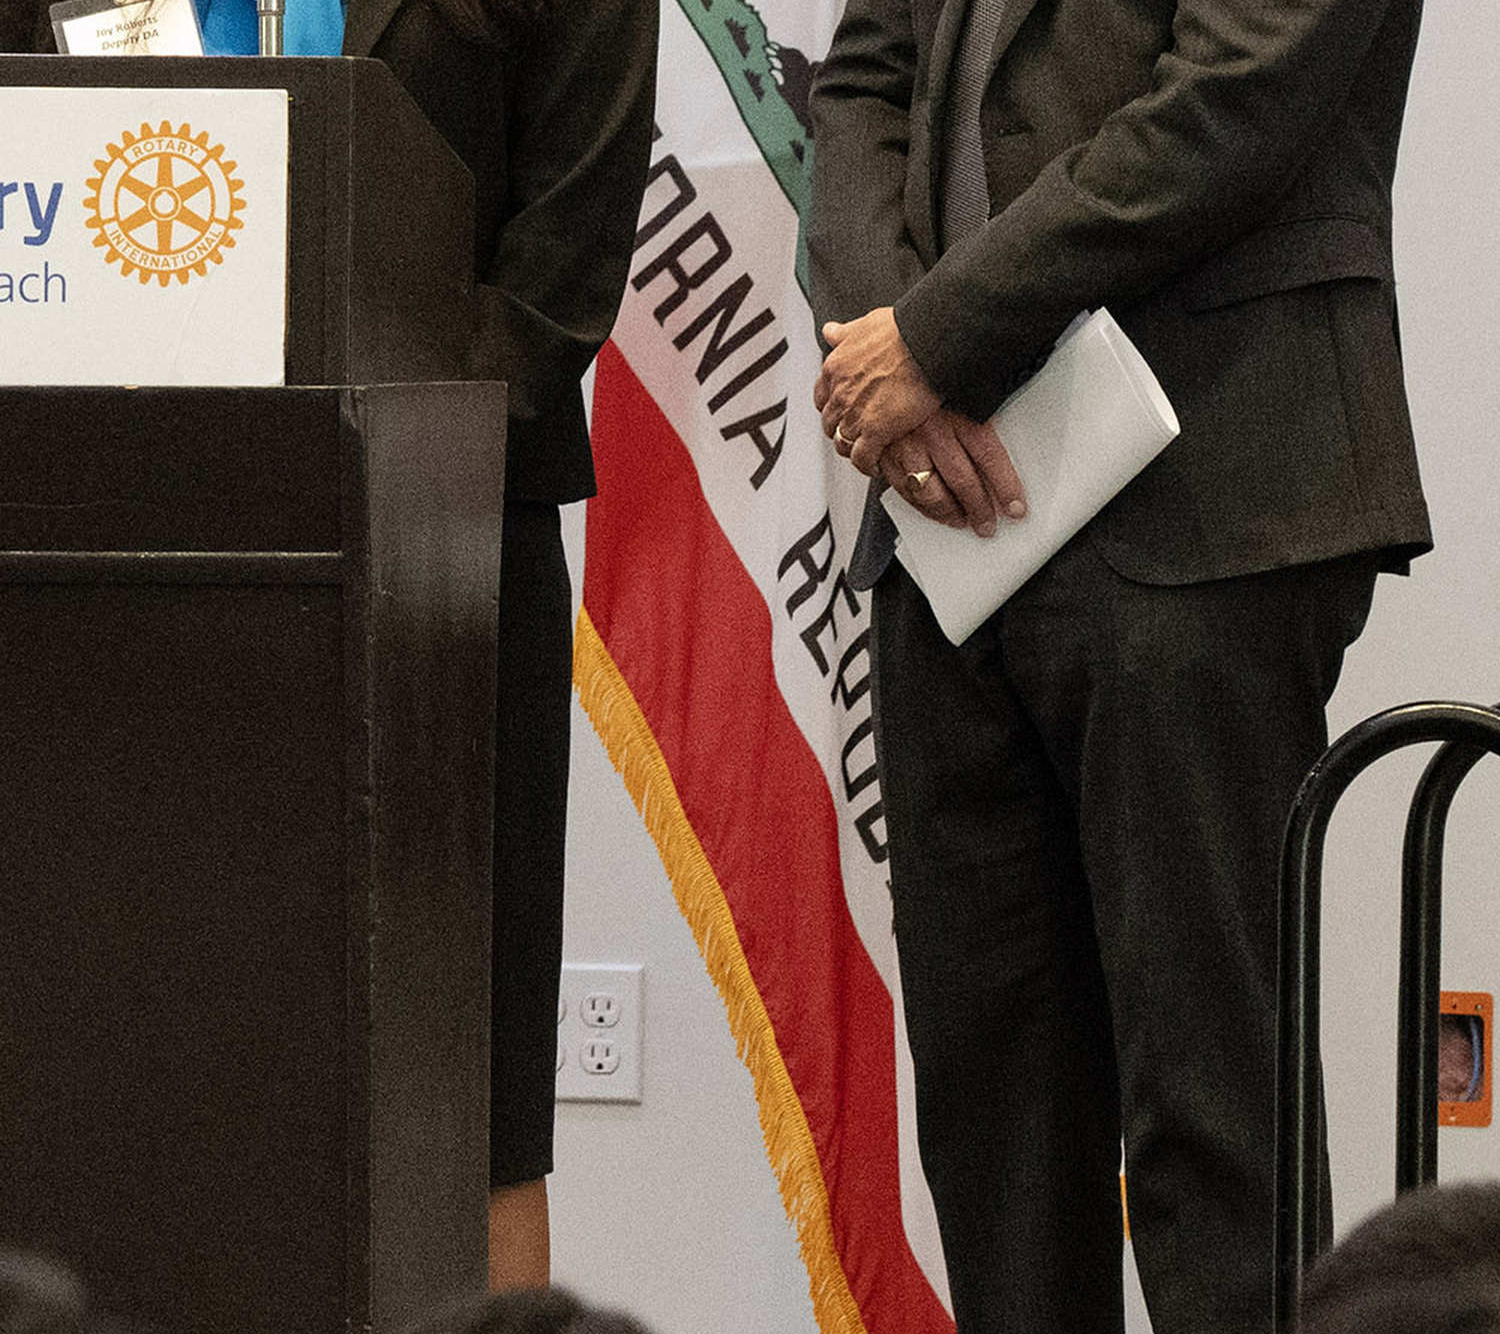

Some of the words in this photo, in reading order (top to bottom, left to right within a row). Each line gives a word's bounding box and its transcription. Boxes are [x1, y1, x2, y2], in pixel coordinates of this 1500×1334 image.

[115, 16, 159, 32] Roberts
[102, 33, 140, 50] Deputy
[142, 29, 159, 40] DA
[132, 138, 199, 158] ROTARY
[109, 228, 222, 269] INTERNATIONAL
[631, 124, 789, 491] ORNIA
